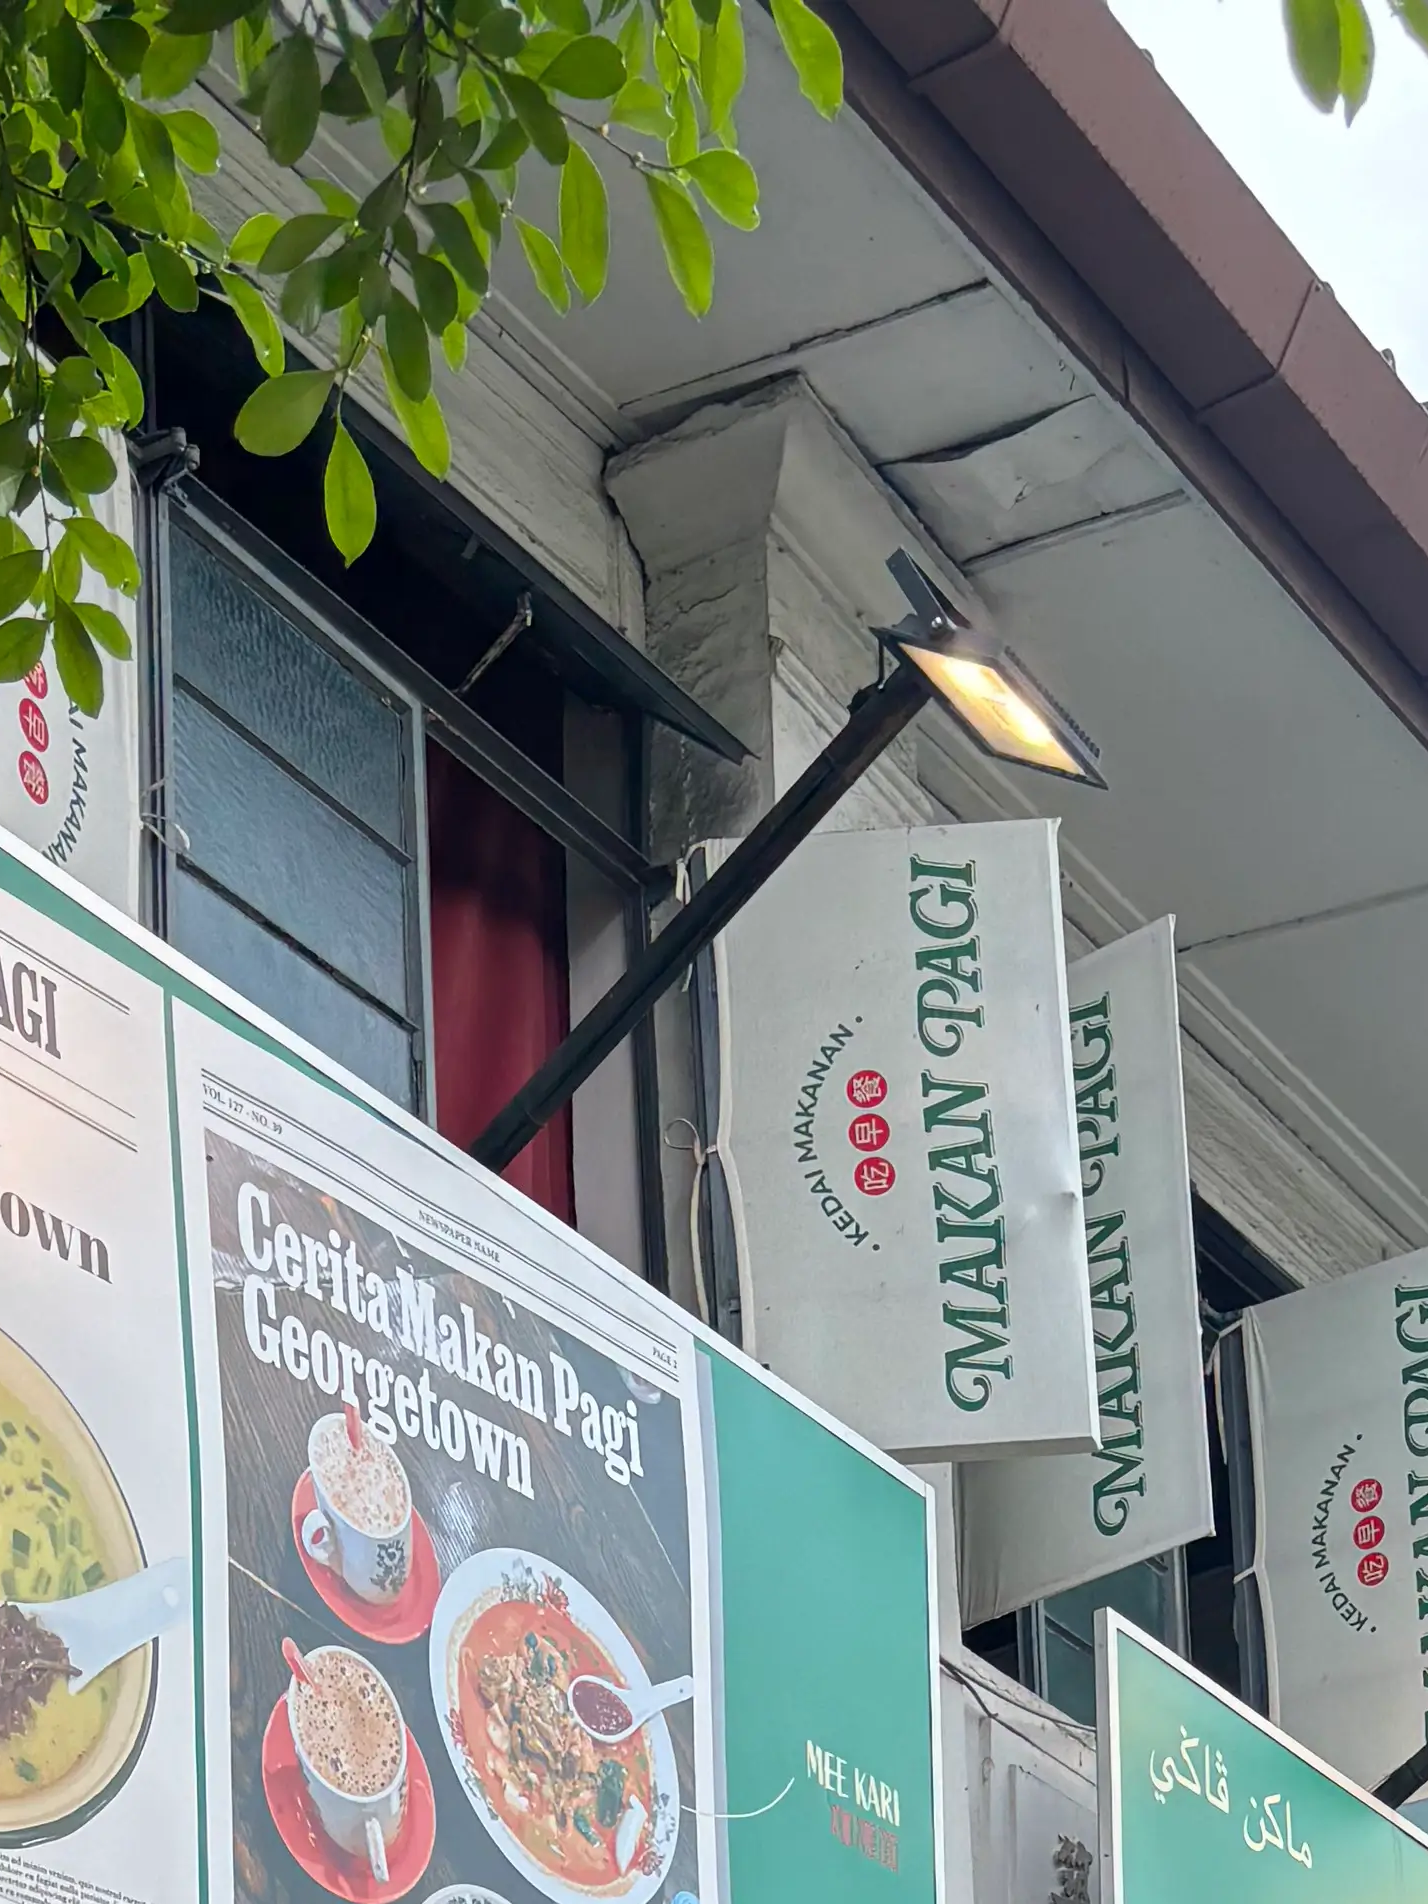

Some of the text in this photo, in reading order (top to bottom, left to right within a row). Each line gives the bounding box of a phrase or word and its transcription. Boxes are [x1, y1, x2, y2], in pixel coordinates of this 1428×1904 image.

[908, 853, 985, 1057] PAGI
[793, 1023, 870, 1247] KEDAI MAKANAN
[851, 1074, 891, 1192] 吃早餐
[237, 1181, 643, 1487] Cerita Makan Pagi
[922, 1069, 1015, 1413] MAKAN
[243, 1275, 535, 1500] Georgetown
[1311, 1443, 1369, 1632] KEDAI MAKANAN
[806, 1739, 900, 1827] MEE KARI
